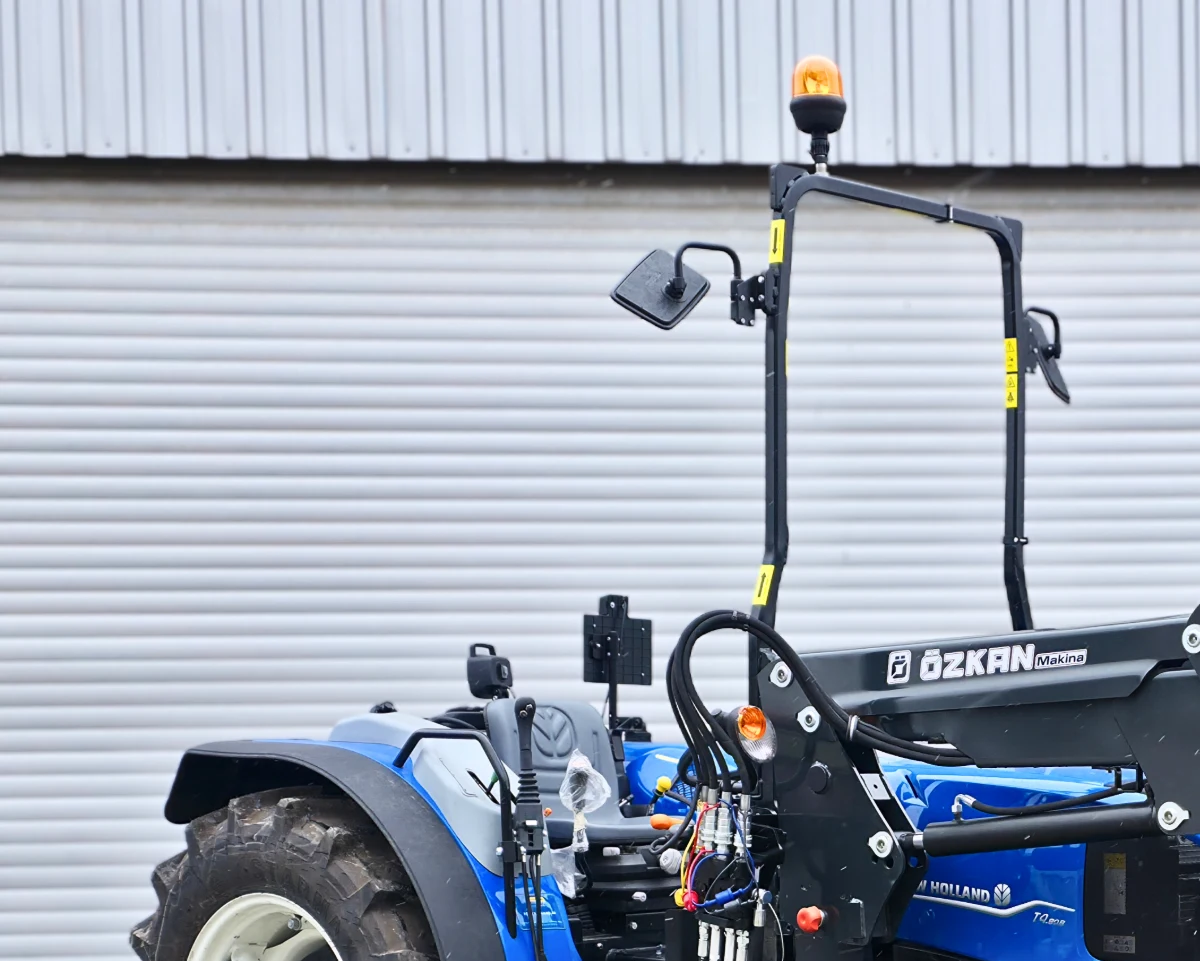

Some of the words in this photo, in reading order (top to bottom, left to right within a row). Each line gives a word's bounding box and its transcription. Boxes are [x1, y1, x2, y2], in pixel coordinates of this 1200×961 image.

[919, 644, 1035, 681] ÖZKAN
[1036, 652, 1085, 668] Makina
[930, 881, 991, 903] HOLLAND
